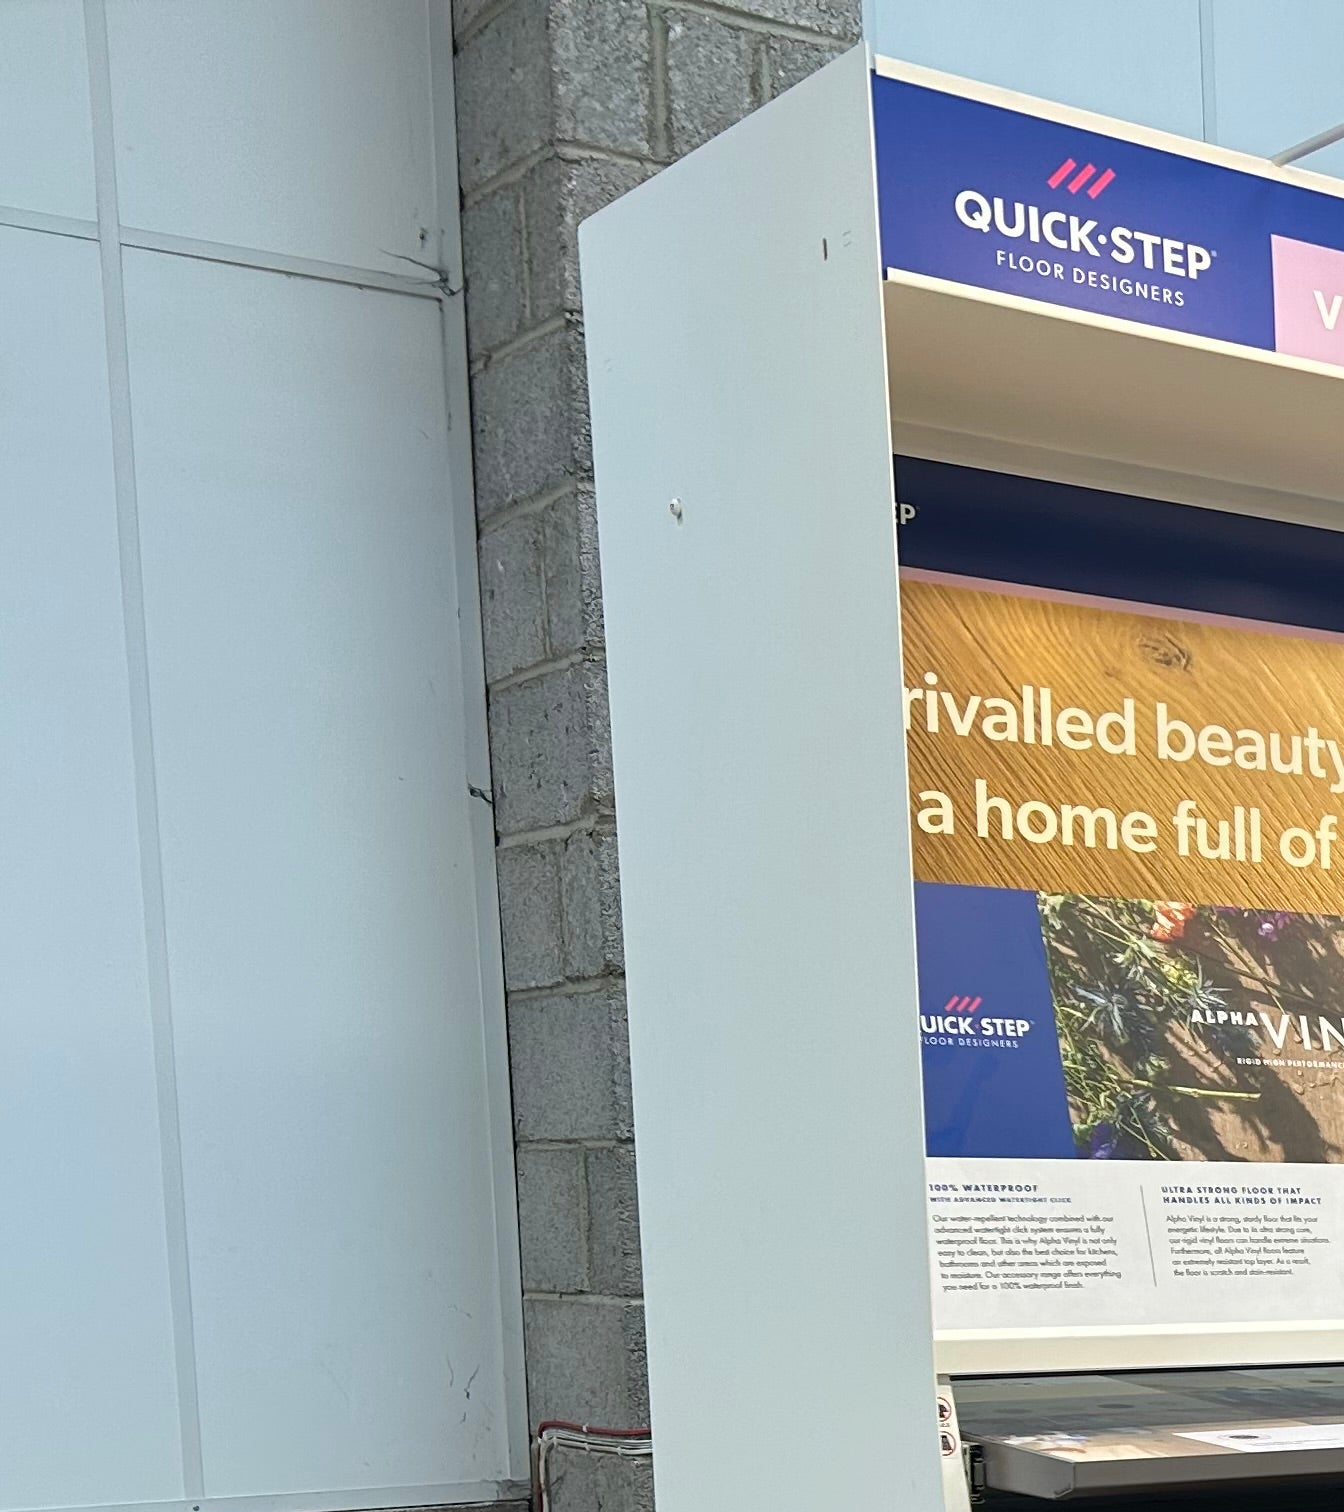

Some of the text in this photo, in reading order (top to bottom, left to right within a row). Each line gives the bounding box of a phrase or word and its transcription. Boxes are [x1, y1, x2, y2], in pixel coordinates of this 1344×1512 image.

[996, 249, 1185, 307] FLOOR DESIGNERS
[917, 790, 955, 836] a
[976, 779, 1159, 853] home
[1173, 801, 1262, 863] full
[1280, 816, 1337, 869] of
[1191, 1009, 1260, 1028] ALPHA
[921, 1036, 1019, 1049] LOOR DESIGNERS
[962, 1184, 1038, 1192] WATERPROOF
[1161, 1186, 1301, 1195] ULTRA STRONG FLOOR THAT
[1163, 1196, 1322, 1205] HANDLES ALL KINDS OF IMPACT
